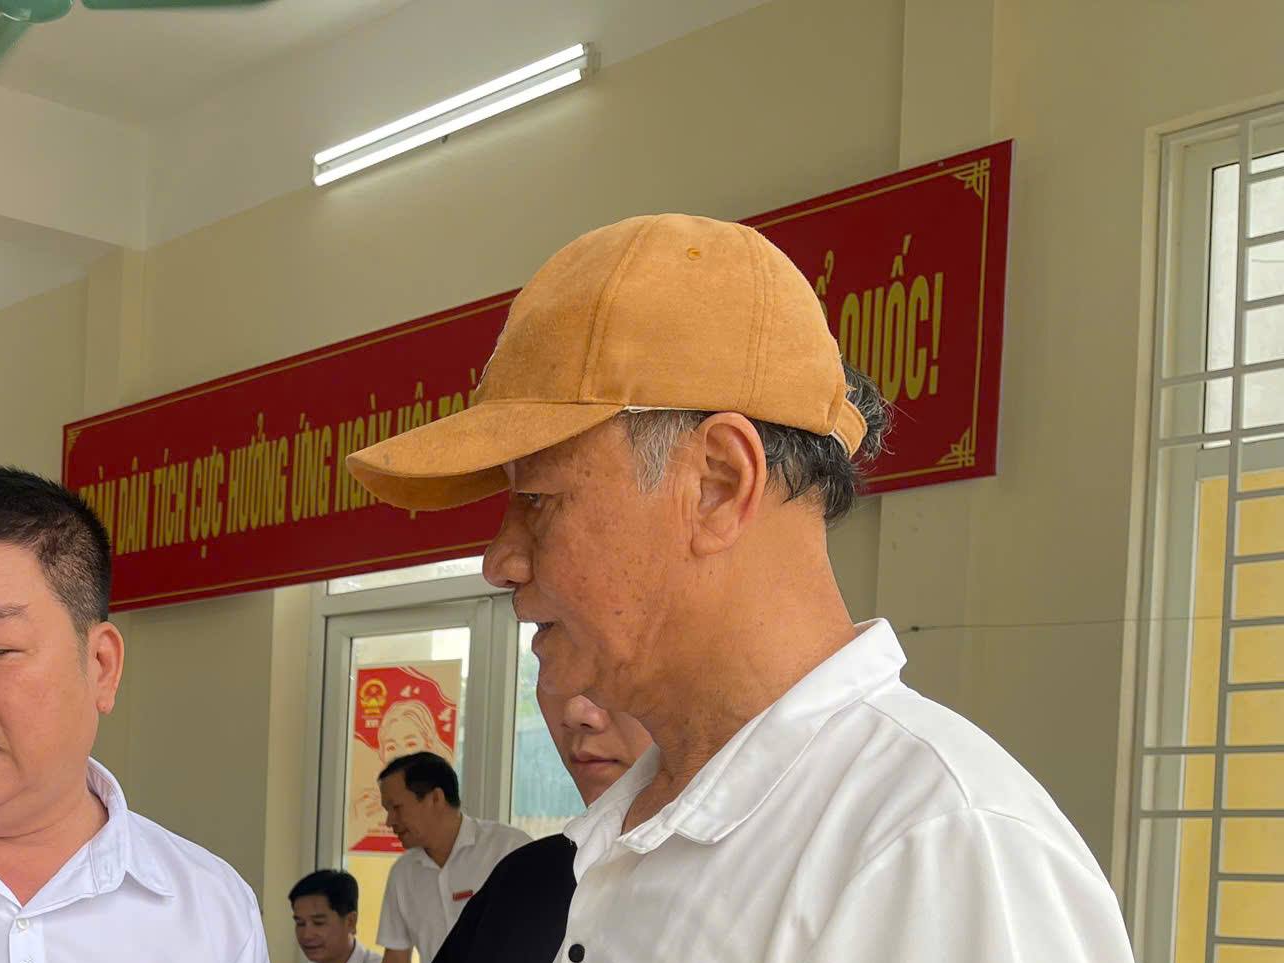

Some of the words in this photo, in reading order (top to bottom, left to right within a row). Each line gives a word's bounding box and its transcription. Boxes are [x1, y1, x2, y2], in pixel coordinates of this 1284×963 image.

[116, 455, 150, 556] DÂN
[152, 447, 188, 549] TÍCH
[190, 445, 225, 560] CỰC
[226, 411, 289, 534] HƯỞNG
[291, 412, 332, 522] ỨNG
